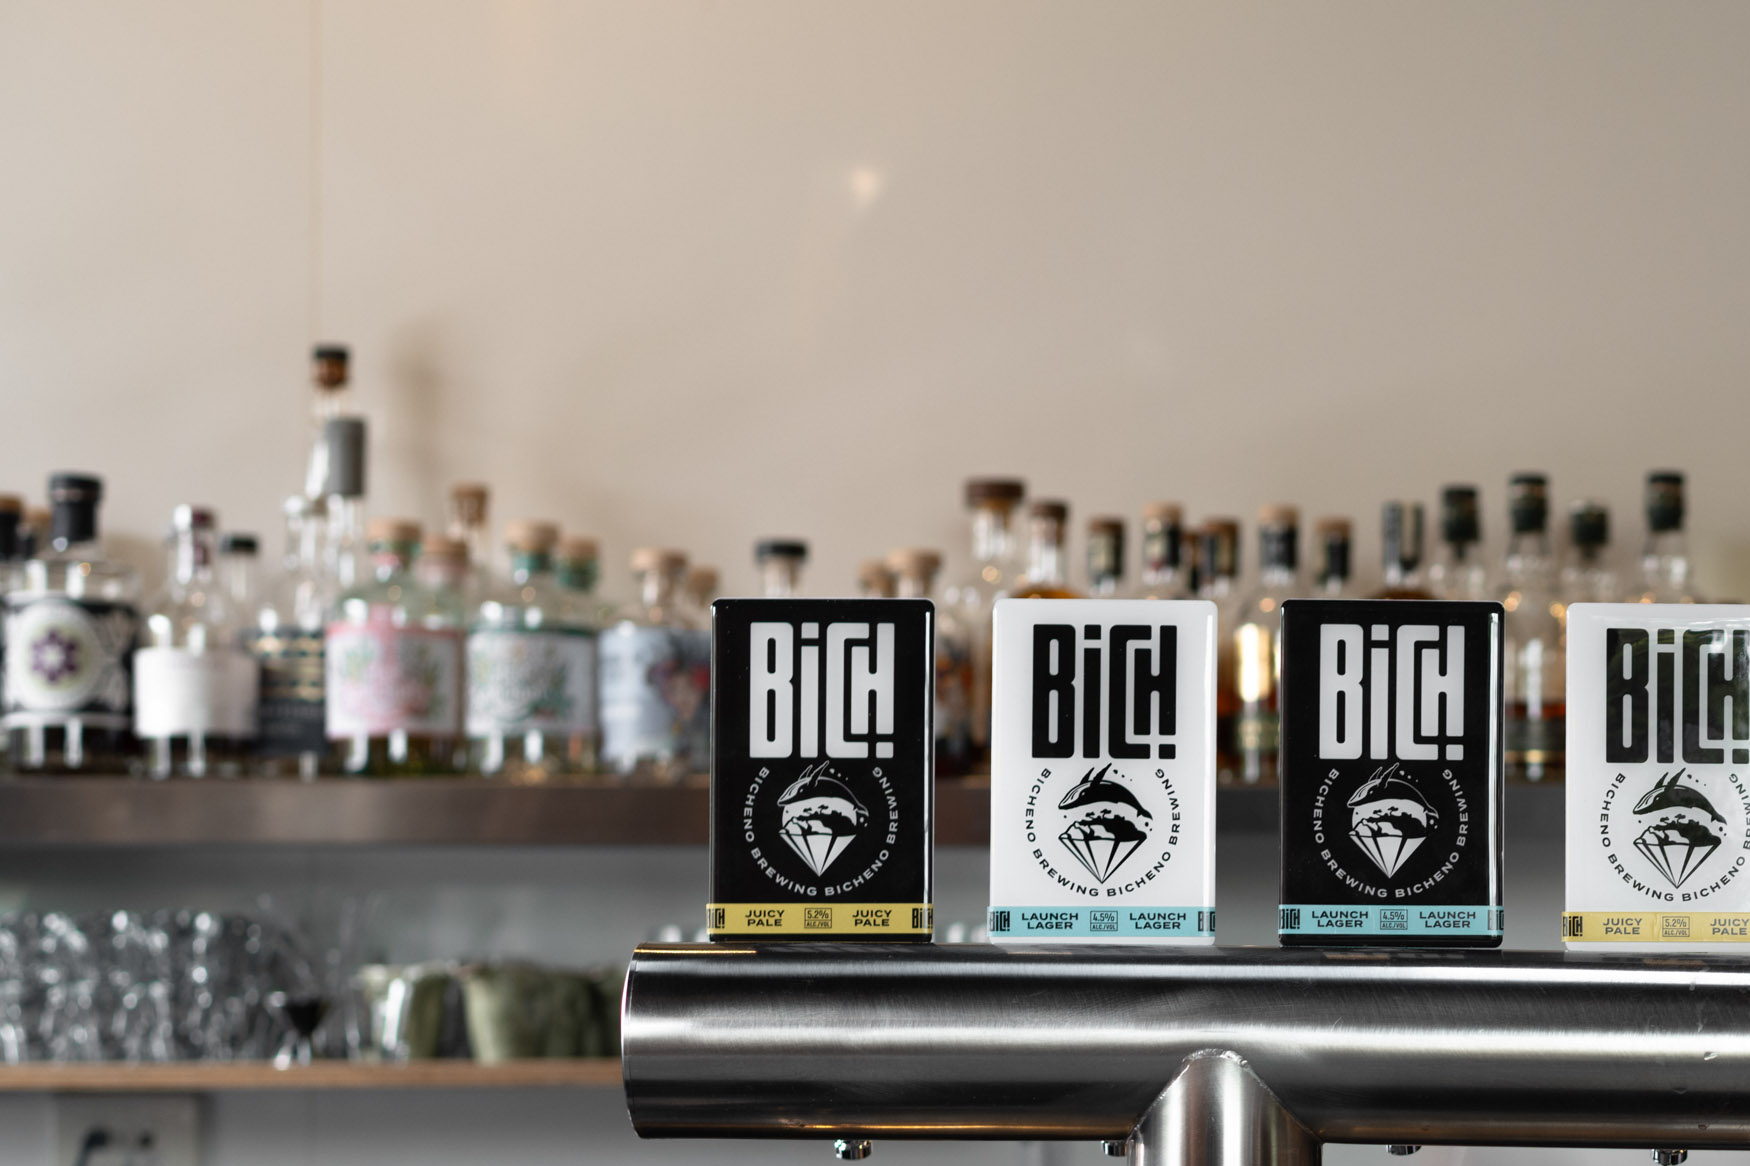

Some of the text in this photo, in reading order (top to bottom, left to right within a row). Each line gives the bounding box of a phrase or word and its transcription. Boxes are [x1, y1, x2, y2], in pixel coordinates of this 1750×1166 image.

[1600, 773, 1626, 848] BICHENO
[744, 766, 898, 896] BICHENO BREWING BICHENO BREWING
[1025, 768, 1180, 897] BICHENO BREWING BICHENO BREWING
[1313, 768, 1468, 898] BICHENO BREWING BICHENO BREWING
[1608, 854, 1674, 902] BREWING
[1682, 856, 1746, 902] BICHENO
[745, 910, 785, 918] JUICY
[807, 910, 829, 919] 5.2%
[852, 910, 892, 918] JUICY
[1022, 913, 1078, 921] LAUNCH
[1092, 912, 1115, 922] 4.5%
[1130, 913, 1186, 921] LAUNCH
[1312, 911, 1368, 919] LAUNCH
[1382, 911, 1405, 920] 4.5%
[1420, 911, 1476, 919] LAUNCH
[747, 919, 782, 927] PALE
[854, 919, 890, 927] PALE
[1027, 922, 1073, 930] LAGER
[1135, 922, 1181, 930] LAGER
[1317, 920, 1363, 928] LAGER
[1425, 920, 1471, 928] LAGER
[1603, 918, 1643, 926] JUICY
[1665, 918, 1687, 928] 5.2%
[1710, 918, 1750, 927] JUICY
[1605, 927, 1640, 935] PALE
